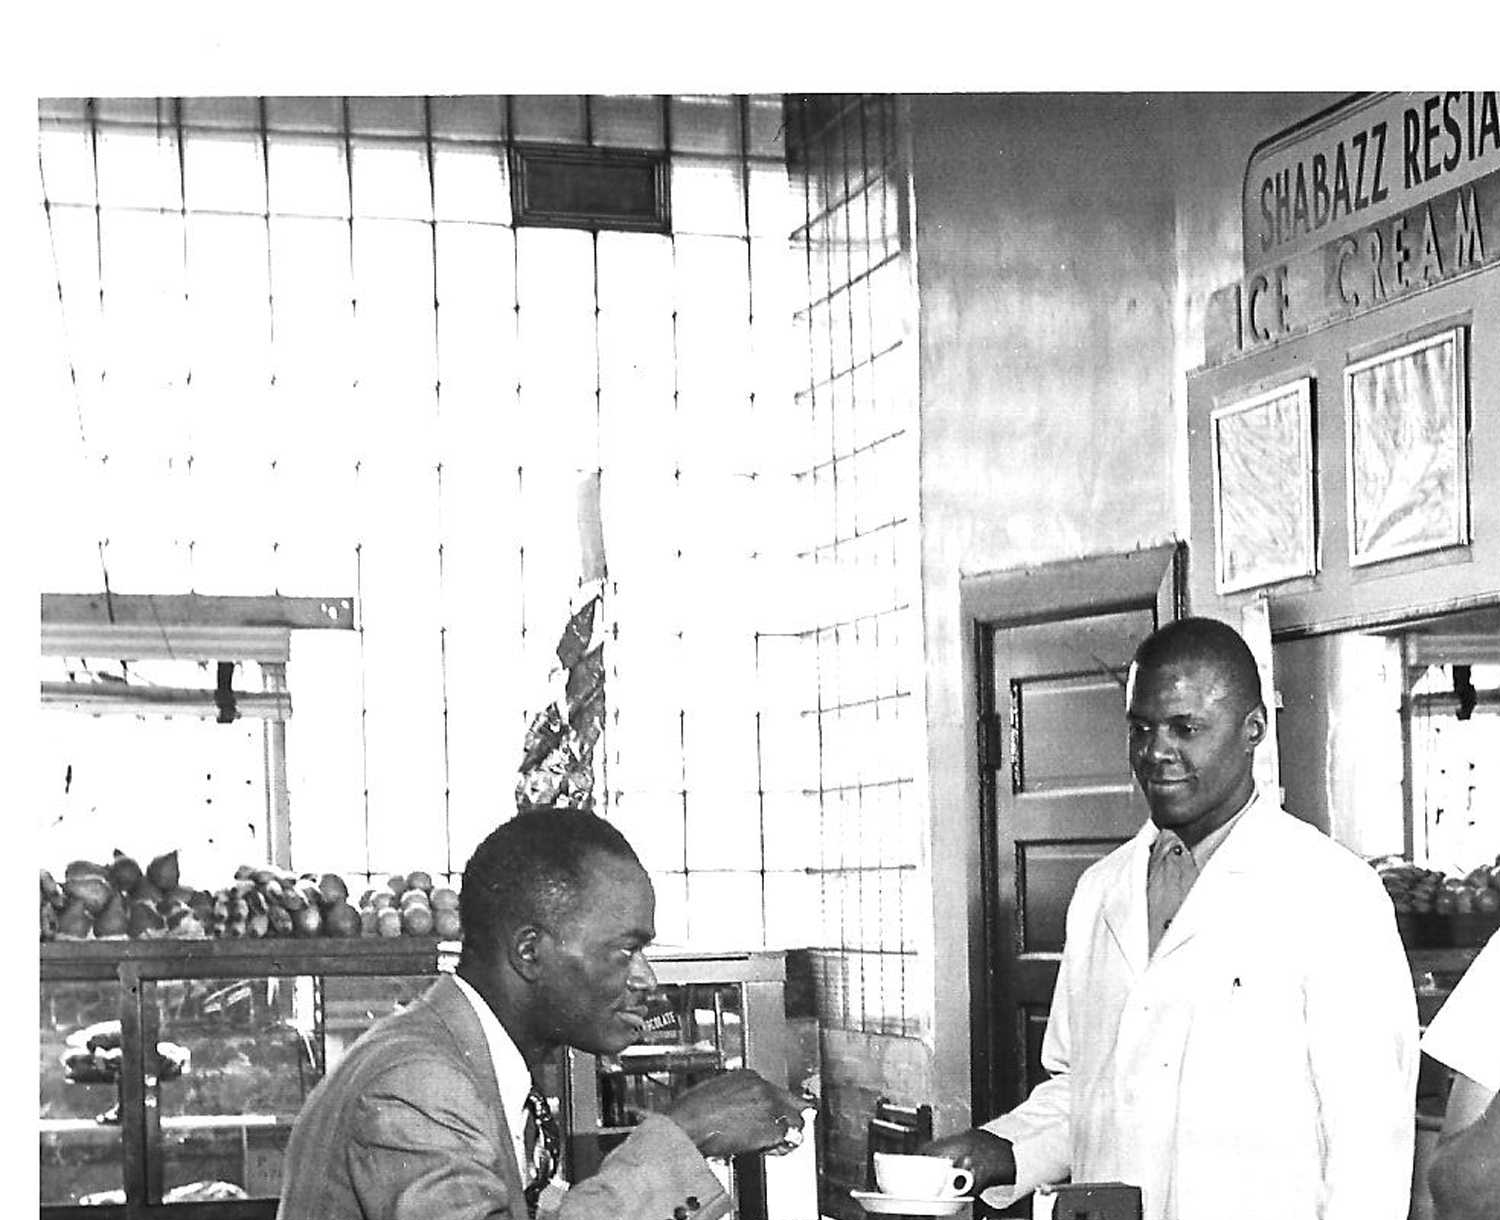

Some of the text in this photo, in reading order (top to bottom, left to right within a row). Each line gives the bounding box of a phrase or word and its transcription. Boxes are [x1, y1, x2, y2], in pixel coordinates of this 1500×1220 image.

[1261, 121, 1389, 251] SHABAZZ
[1235, 265, 1290, 352] ICE
[1338, 186, 1485, 307] CREAM
